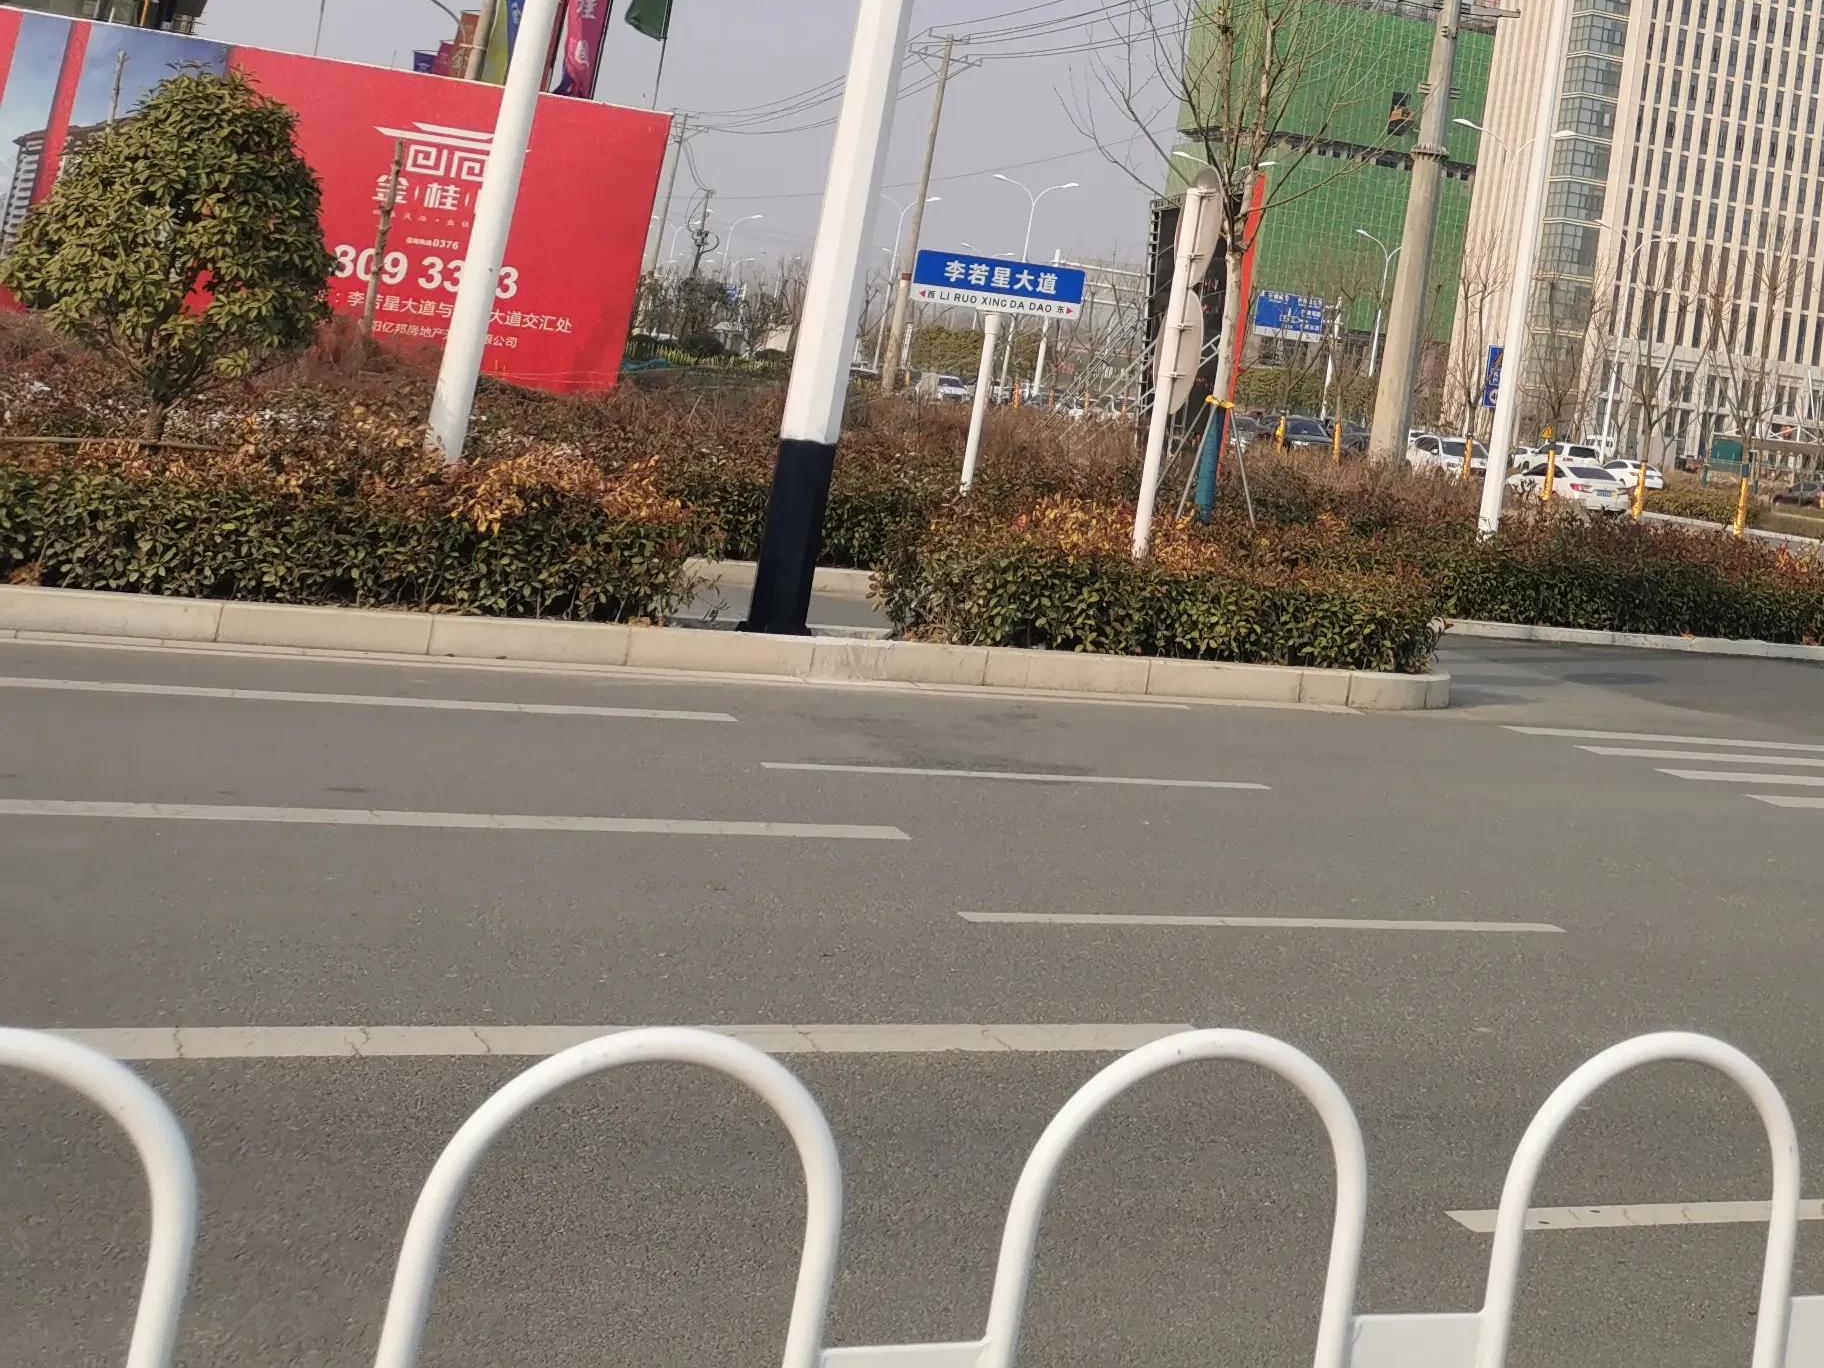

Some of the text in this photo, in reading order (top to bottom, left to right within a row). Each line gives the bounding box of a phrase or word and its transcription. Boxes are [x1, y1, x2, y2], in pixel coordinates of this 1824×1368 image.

[944, 259, 1058, 295] 李若星大道
[927, 289, 1065, 315] 西 LI RUO XING DA DAO 东
